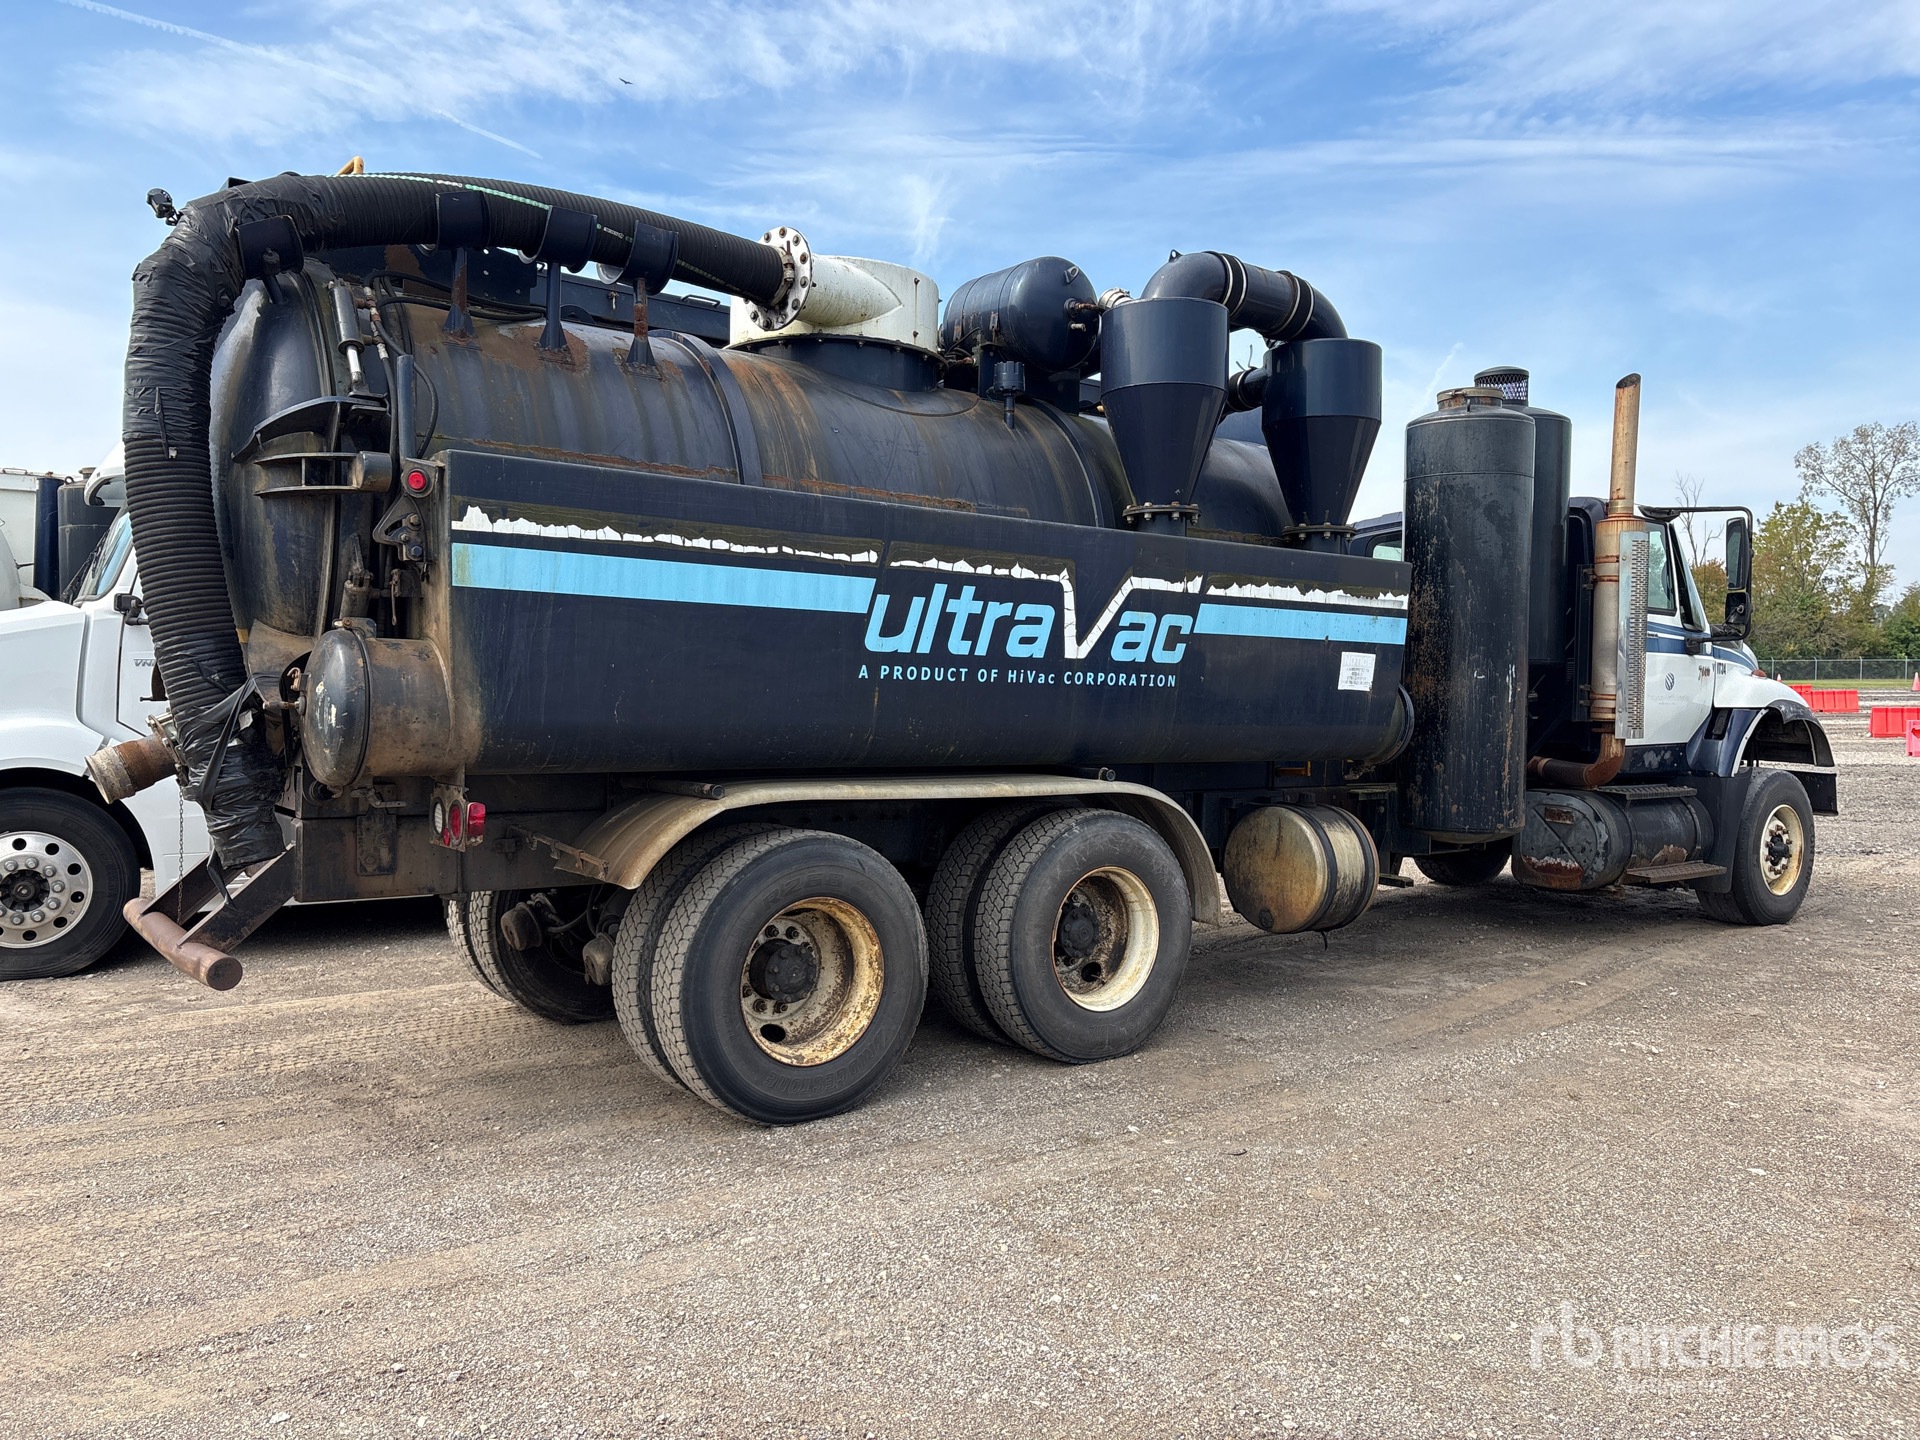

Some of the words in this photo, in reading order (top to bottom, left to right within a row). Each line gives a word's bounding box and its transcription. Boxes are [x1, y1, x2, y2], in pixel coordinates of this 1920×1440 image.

[864, 571, 1194, 664] ultraVac
[858, 664, 869, 679] A
[880, 665, 969, 683] PRODUCT
[977, 669, 998, 684] OF
[1008, 670, 1056, 685] HiVac
[1064, 671, 1177, 688] CORPORATION
